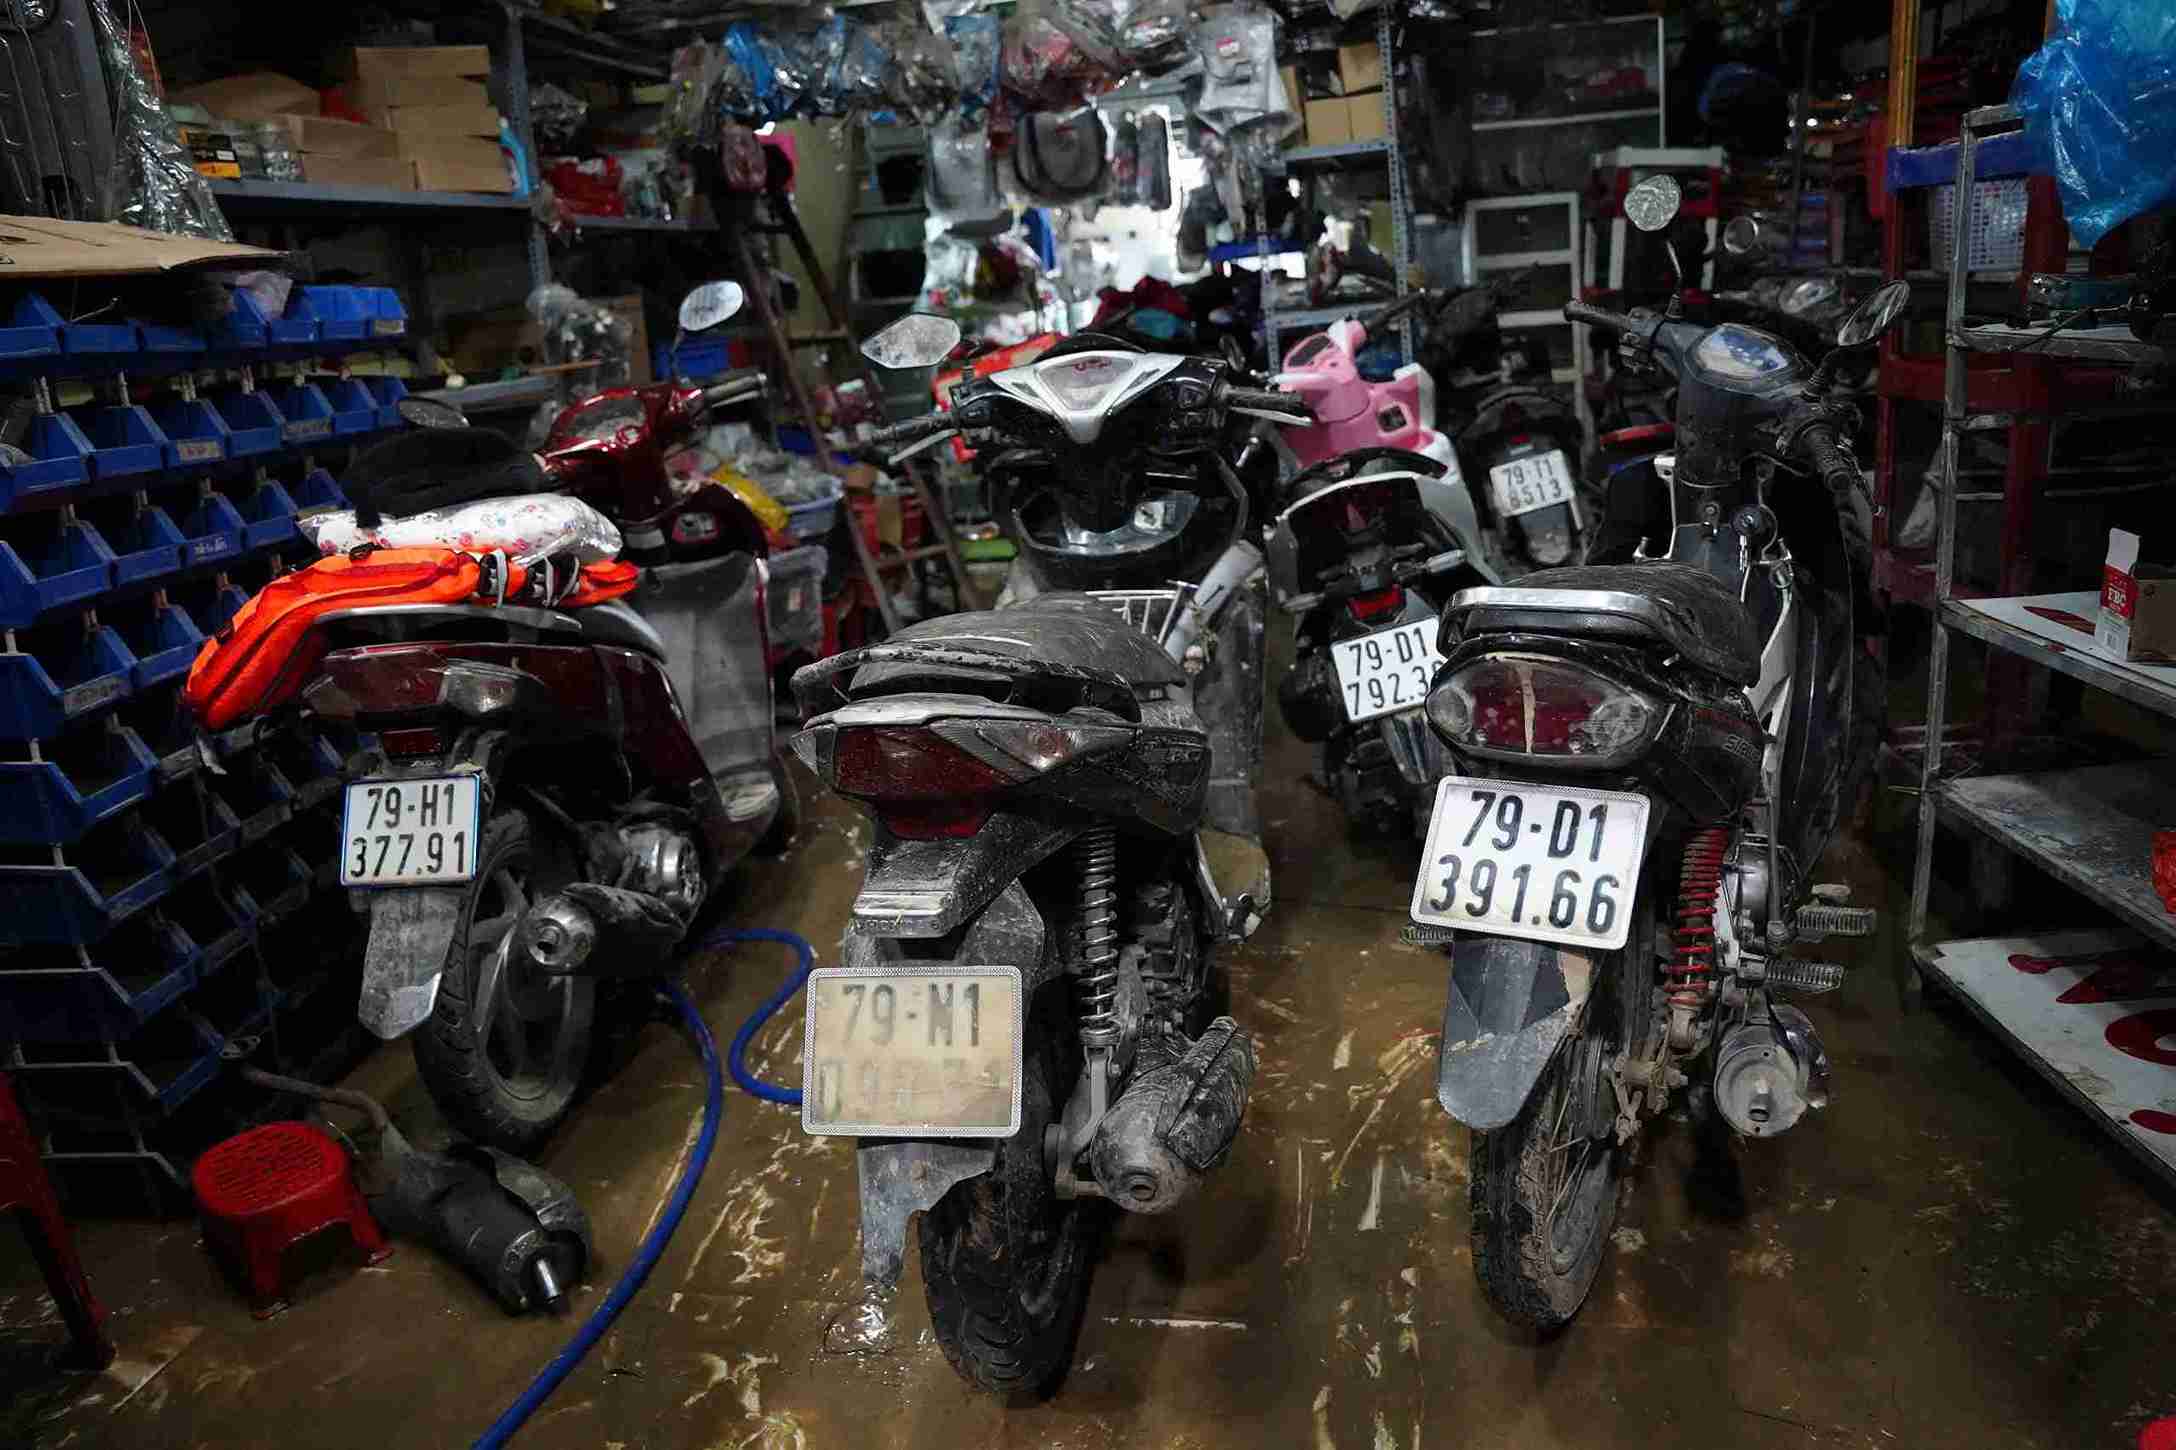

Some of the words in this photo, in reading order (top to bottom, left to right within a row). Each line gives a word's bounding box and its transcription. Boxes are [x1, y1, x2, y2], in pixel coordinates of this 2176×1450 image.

[1503, 458, 1553, 487] 79-T1
[1348, 626, 1428, 676] 79-D1
[366, 783, 455, 830] 79-H1
[1462, 790, 1608, 862] 79-D1
[350, 831, 466, 878] 377.91
[1429, 853, 1619, 934] 391.66
[842, 982, 980, 1048] 79-N1
